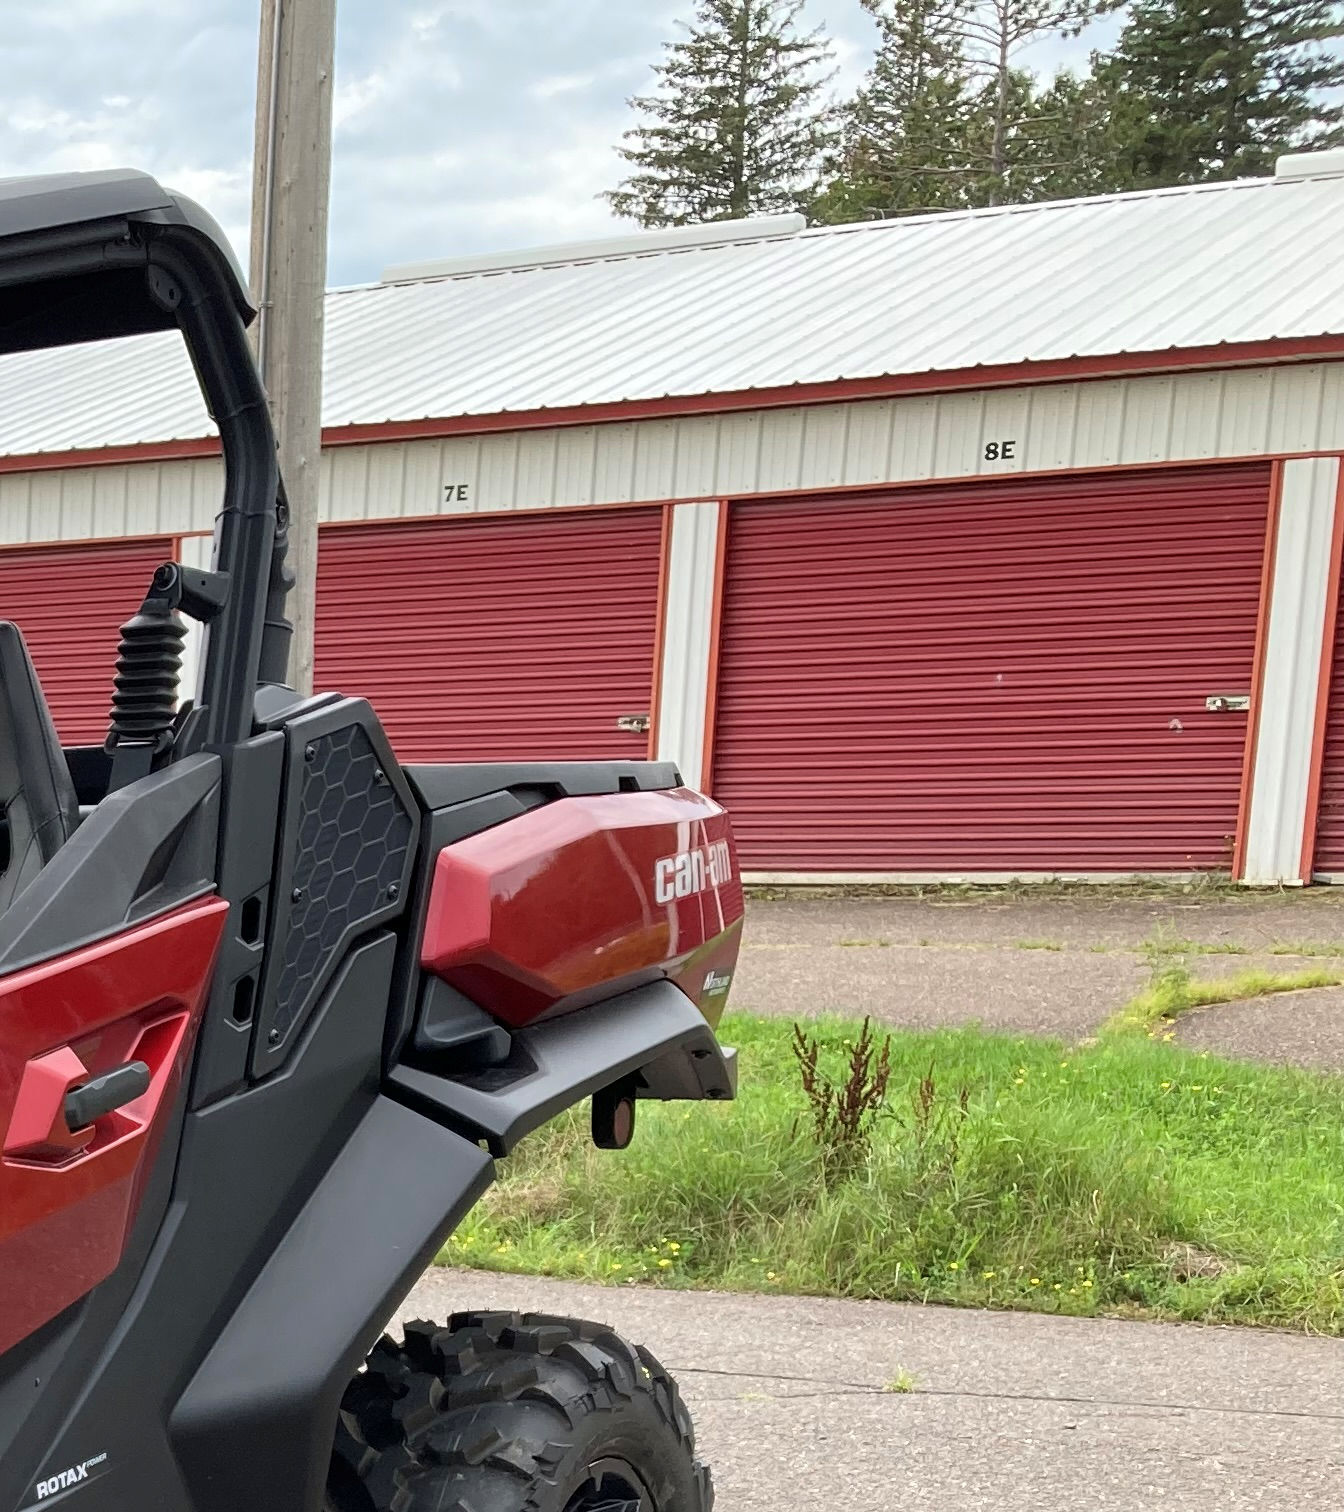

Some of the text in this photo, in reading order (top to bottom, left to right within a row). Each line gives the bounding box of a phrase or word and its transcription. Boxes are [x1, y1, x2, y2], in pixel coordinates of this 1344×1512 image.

[984, 441, 1016, 461] 8E
[444, 484, 469, 502] 7E
[36, 1462, 88, 1500] ROTAX
